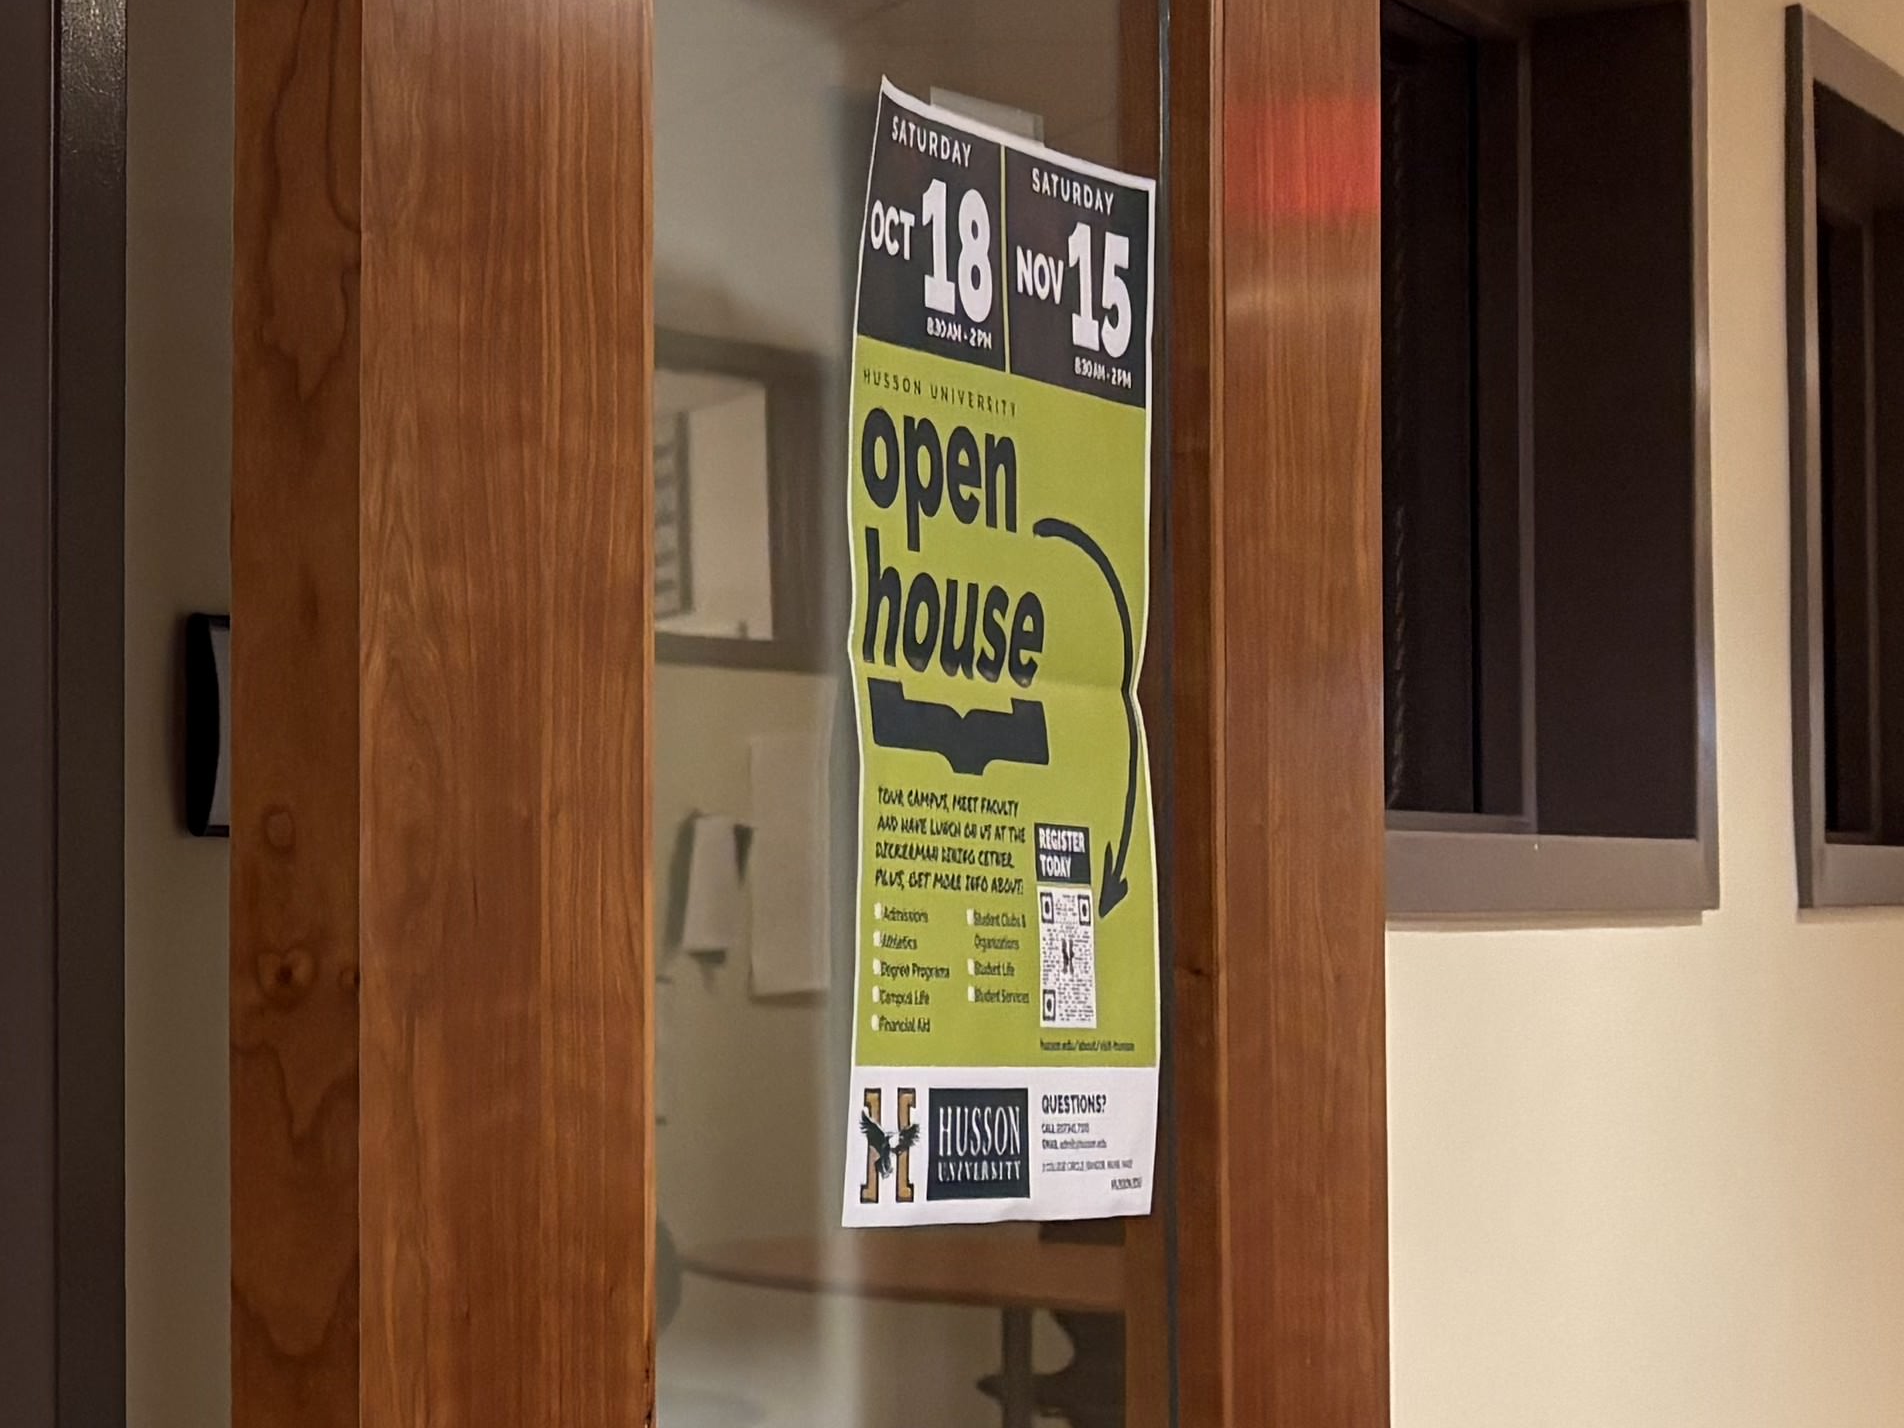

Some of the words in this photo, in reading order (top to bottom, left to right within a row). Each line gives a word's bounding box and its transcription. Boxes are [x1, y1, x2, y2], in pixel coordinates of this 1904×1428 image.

[892, 116, 972, 168] SATURDAY
[1032, 168, 1114, 216] SATURDAY
[870, 200, 915, 261] OCT
[922, 178, 993, 323] 18
[1016, 246, 1064, 304] NOV
[1068, 222, 1132, 358] 15
[863, 369, 922, 397] HUSSON
[930, 385, 1017, 419] UNIVERSITY
[861, 407, 1017, 552] open
[862, 526, 1045, 688] house
[952, 793, 979, 814] MEET
[980, 795, 1020, 819] FACULTY
[994, 824, 1006, 841] AT
[1007, 825, 1026, 845] THE
[1039, 827, 1086, 853] REGISTER
[1039, 853, 1072, 879] TODAY
[907, 870, 932, 890] GET
[880, 958, 910, 981] Degree
[911, 961, 951, 982] Programs
[878, 1014, 917, 1033] Financial
[917, 1016, 931, 1033] Aid
[1041, 1093, 1107, 1115] QUESTIONS?
[938, 1104, 1021, 1157] HUSSON
[937, 1159, 1021, 1184] UNIVERSITY
